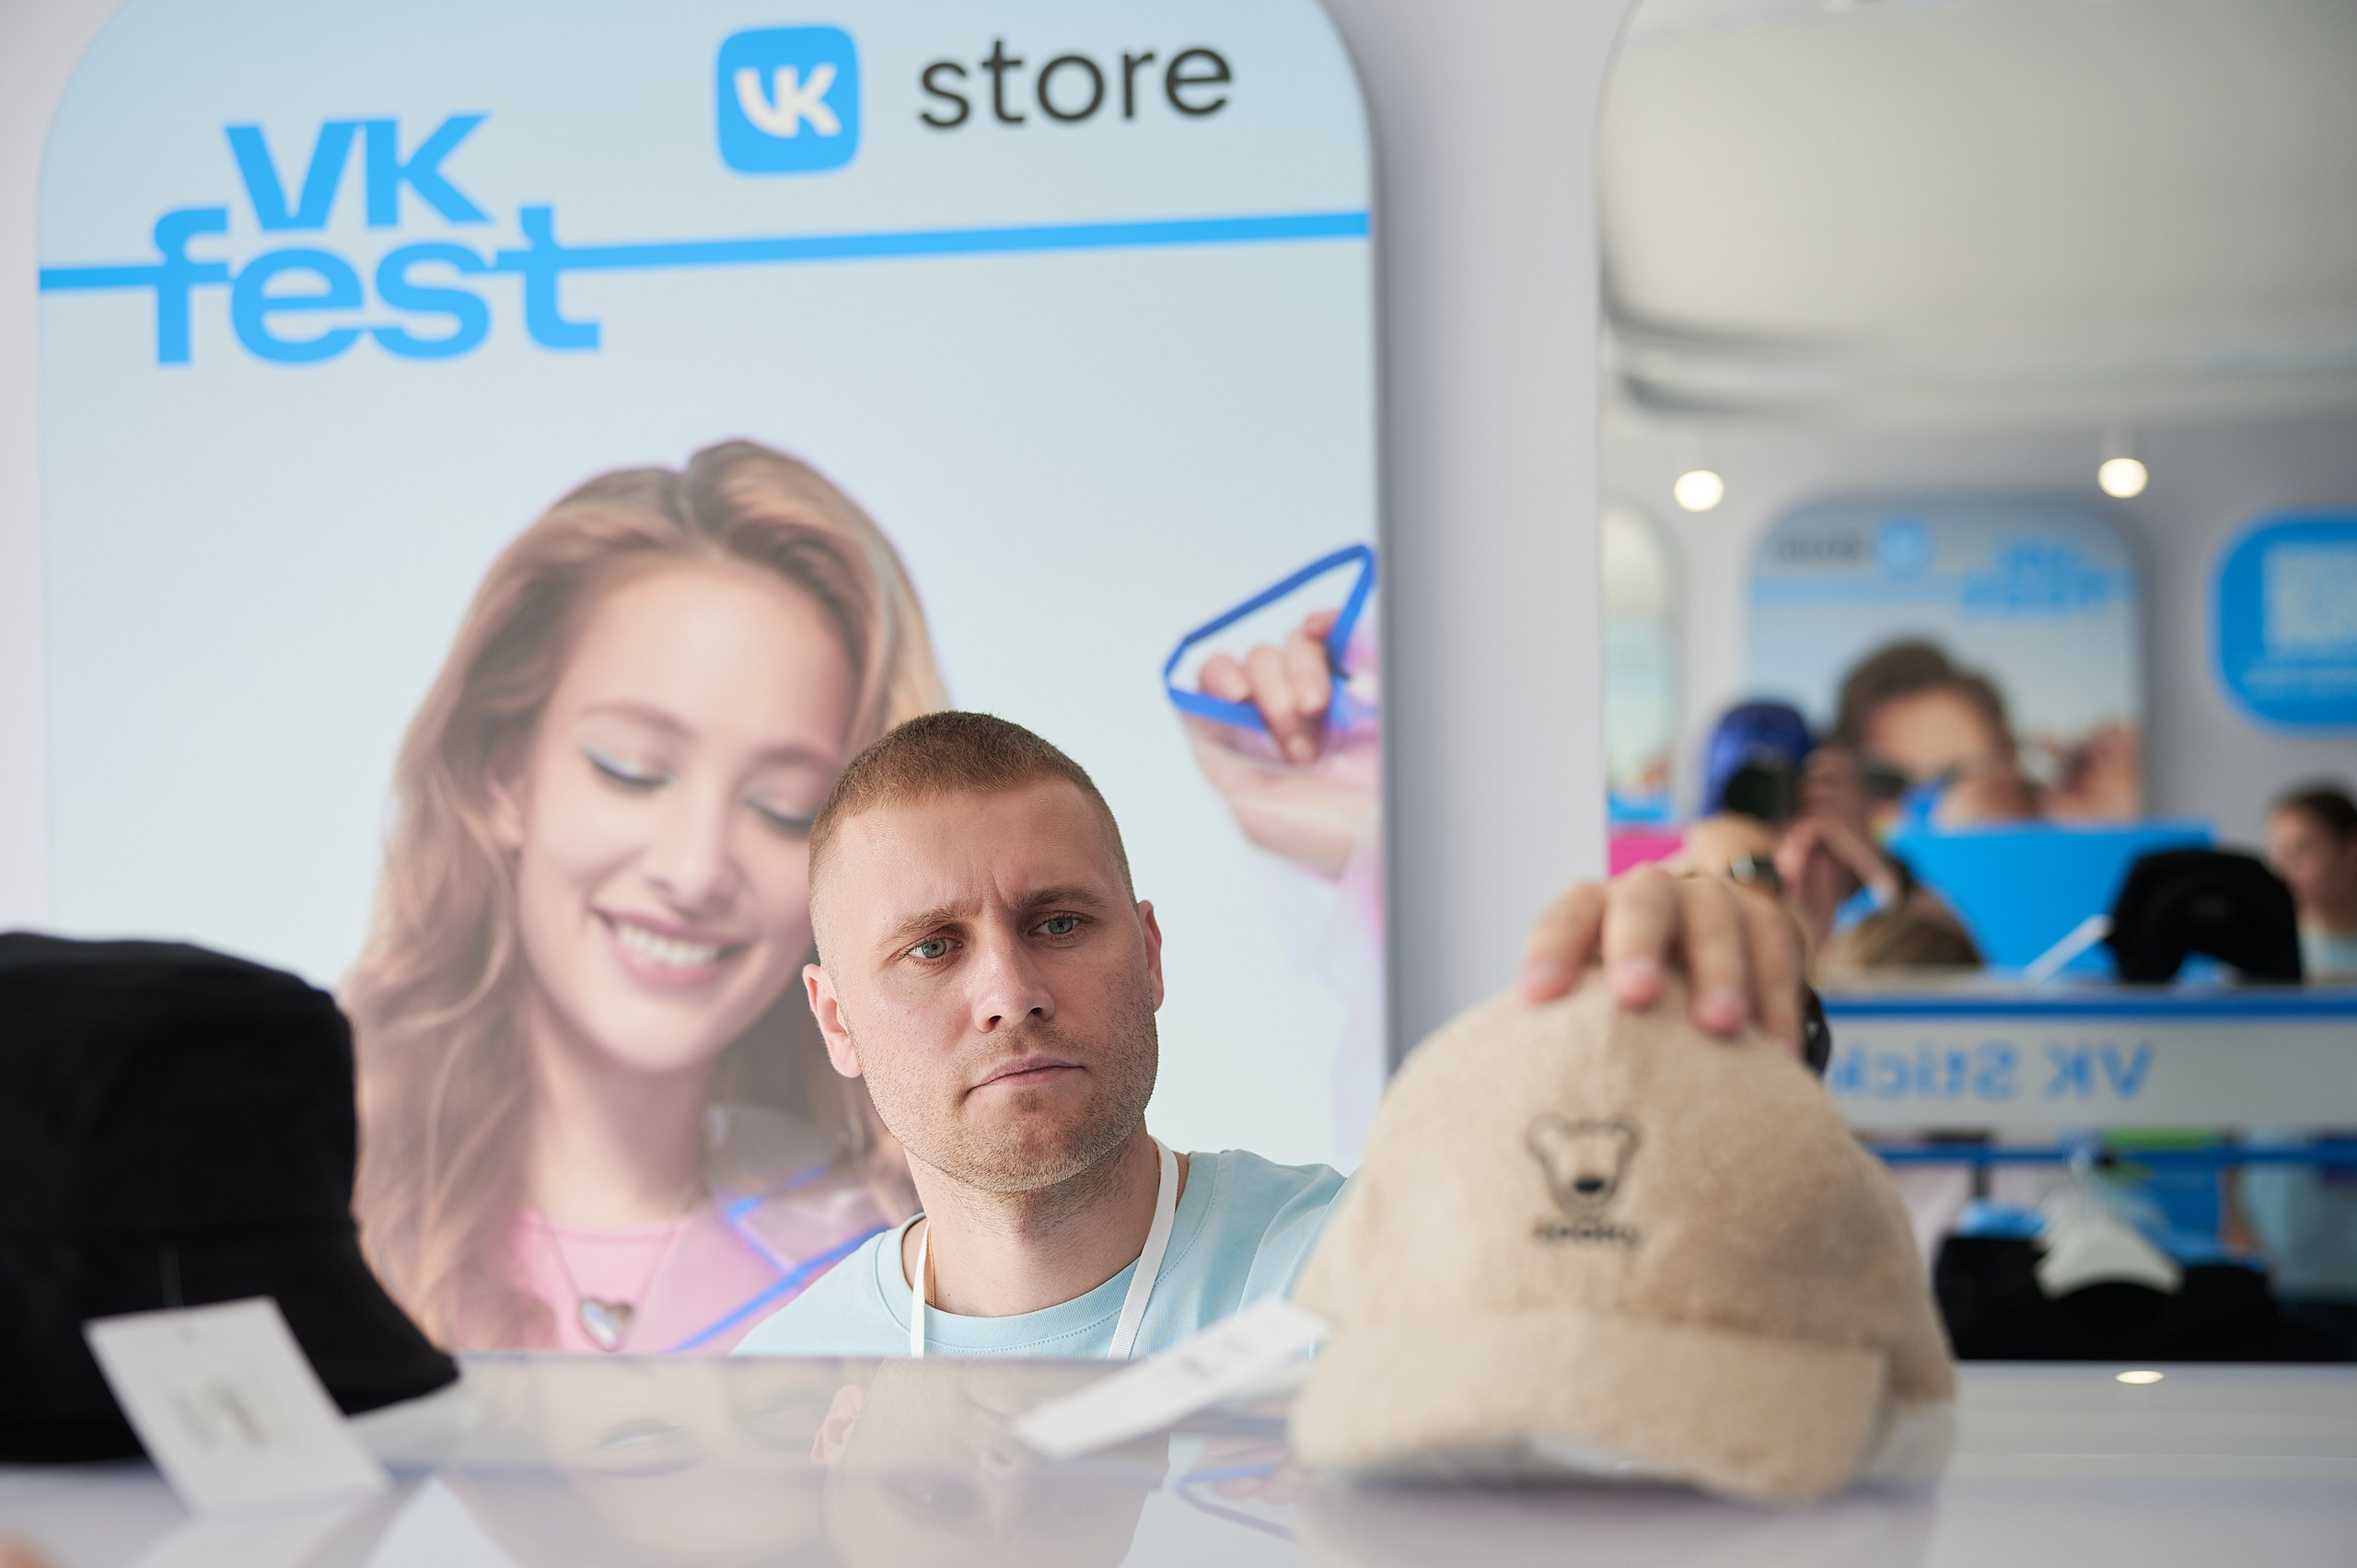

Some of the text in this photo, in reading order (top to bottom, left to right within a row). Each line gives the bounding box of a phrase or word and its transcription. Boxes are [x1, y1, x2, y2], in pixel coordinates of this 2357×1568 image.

[734, 39, 1231, 138] VK store
[224, 110, 494, 233] VK
[152, 202, 603, 366] fest
